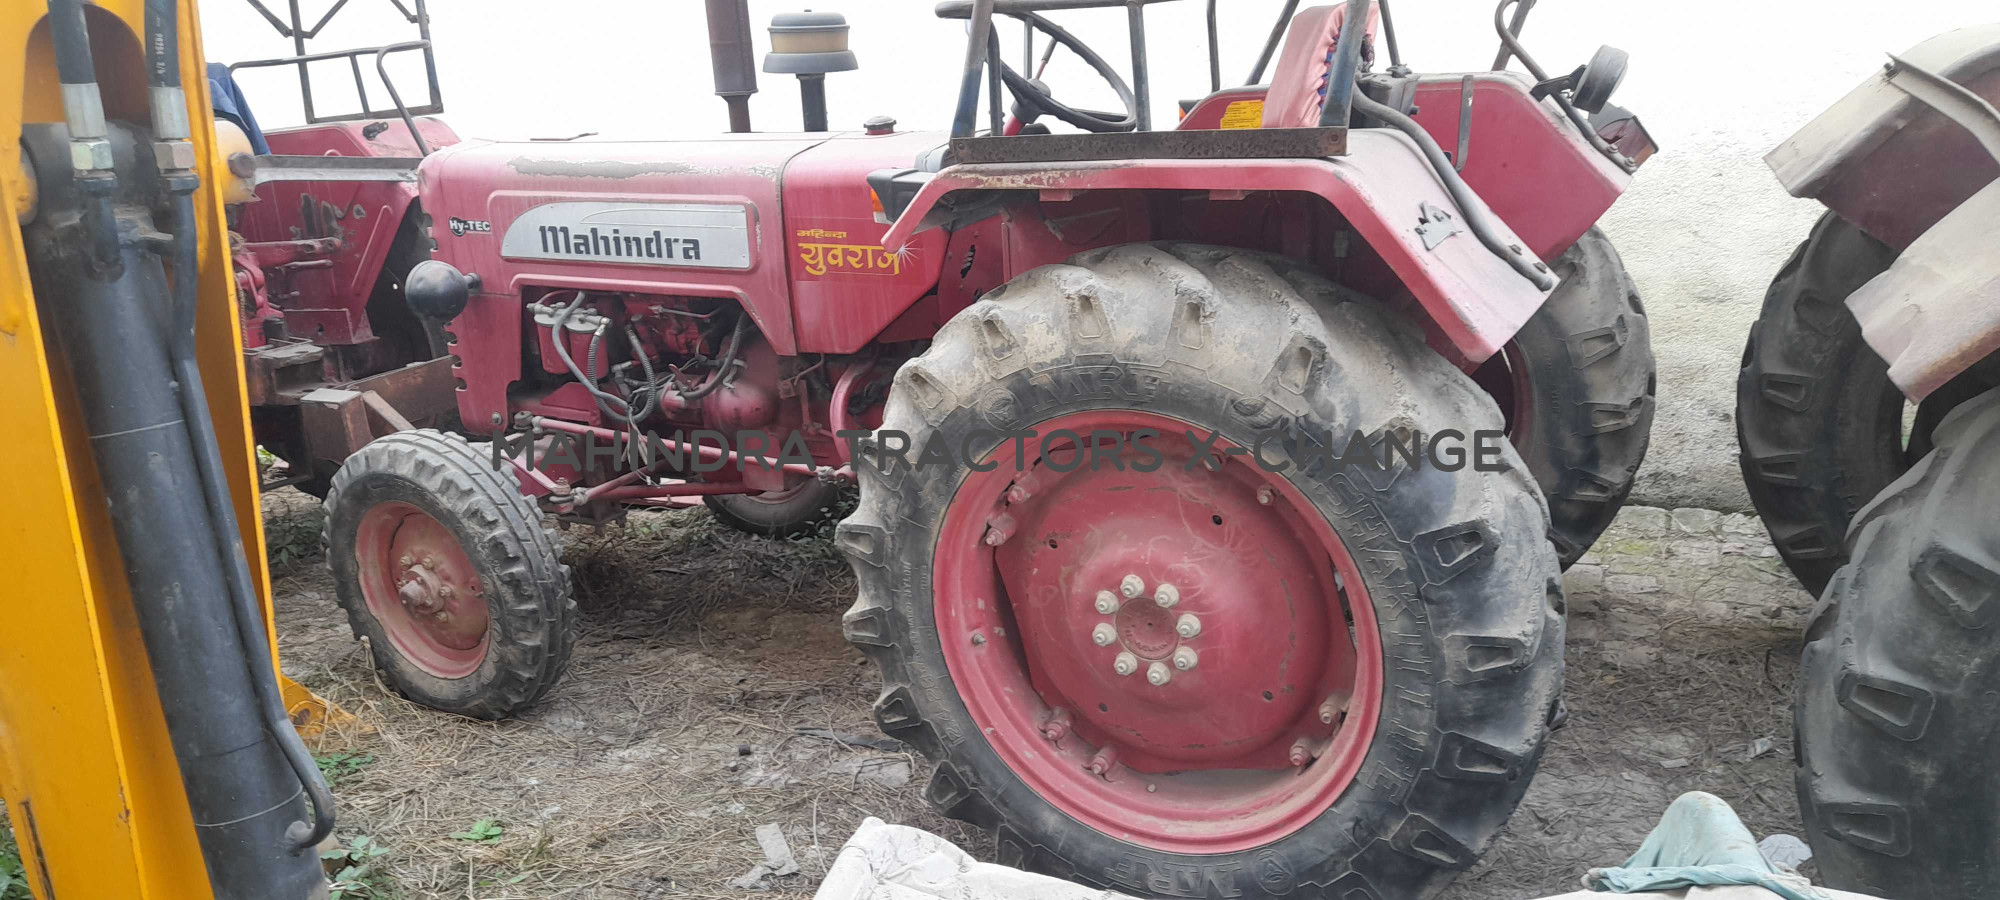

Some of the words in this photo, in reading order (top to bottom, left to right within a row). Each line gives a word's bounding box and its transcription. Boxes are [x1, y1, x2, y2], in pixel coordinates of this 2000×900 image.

[449, 219, 491, 232] Hy-TEC
[538, 224, 702, 261] Mahindra
[1029, 364, 1173, 413] MRF
